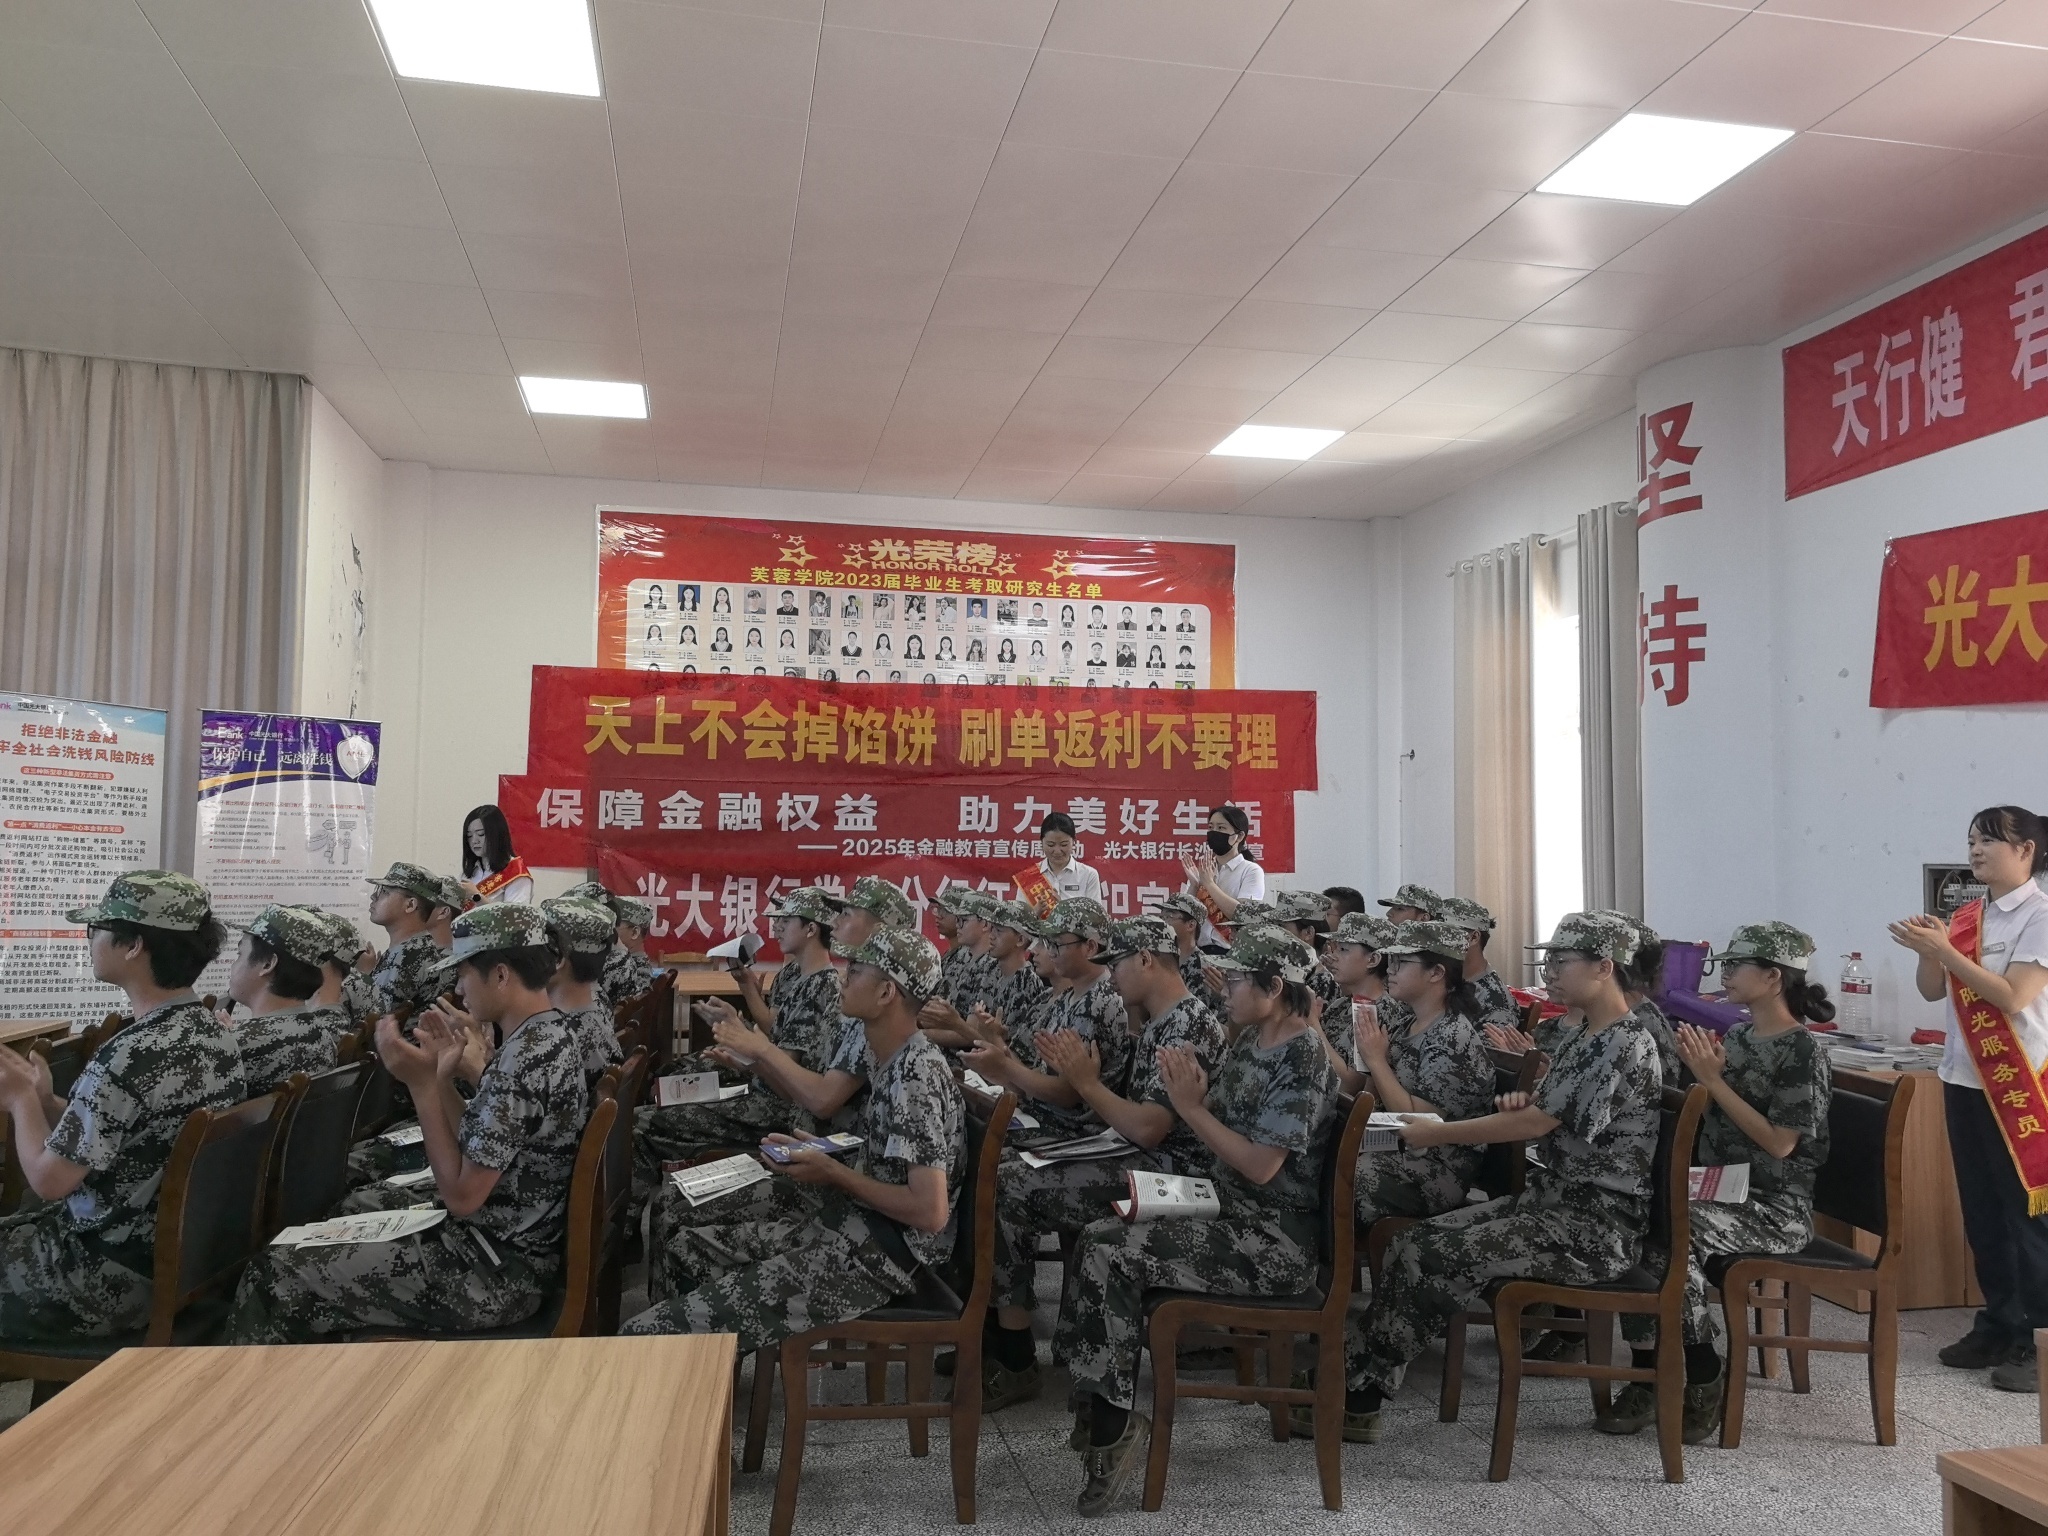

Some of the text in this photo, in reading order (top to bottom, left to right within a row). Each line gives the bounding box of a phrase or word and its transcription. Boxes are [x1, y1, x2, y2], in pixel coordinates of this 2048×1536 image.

[1831, 305, 1966, 458] 天行健
[867, 538, 998, 566] 光荣榜
[751, 567, 1104, 598] 芙蓉学院2023届毕业生考取研究生名单
[871, 560, 993, 576] HONOR ROLL
[1923, 554, 2048, 673] 光大
[18, 702, 53, 711] 中国光大银
[584, 694, 1279, 770] 天上不会掉馅饼 刷单返利不要理
[537, 787, 878, 832] 保障金融权益
[798, 837, 1264, 861] ——2025年金融教育宣传周动 光大银行长沙宣
